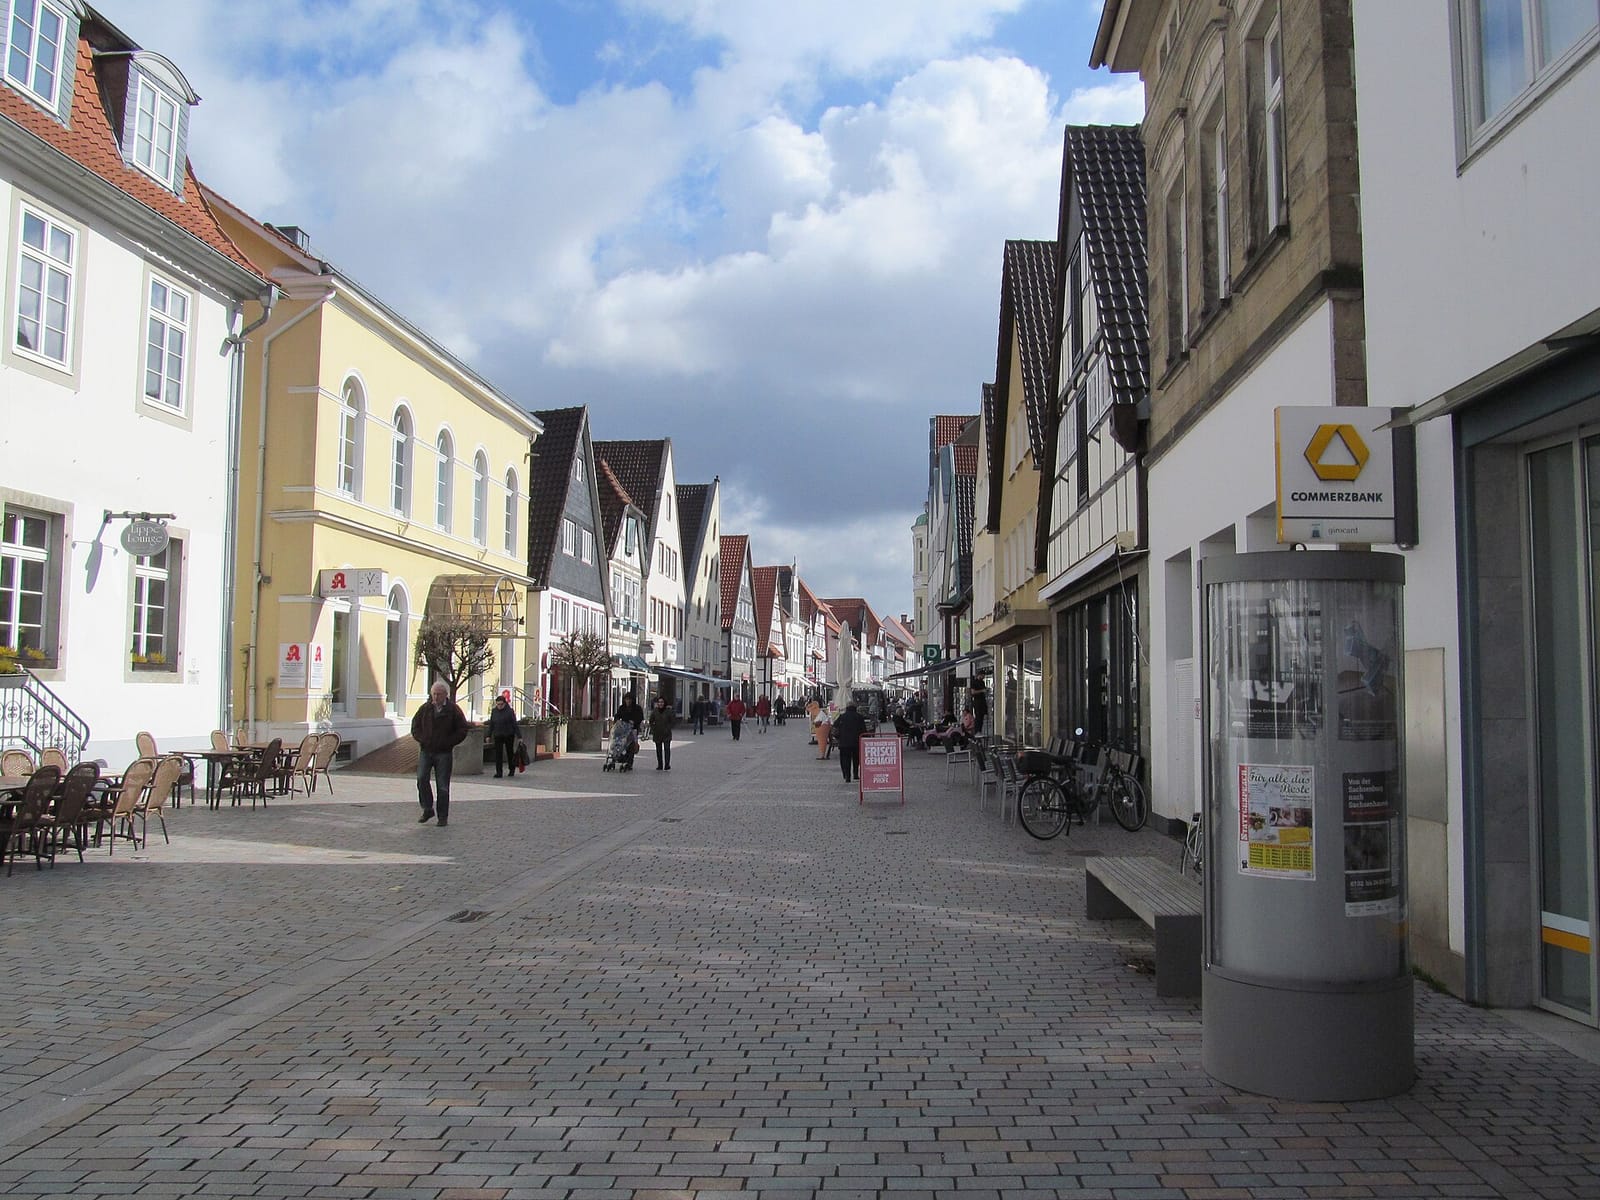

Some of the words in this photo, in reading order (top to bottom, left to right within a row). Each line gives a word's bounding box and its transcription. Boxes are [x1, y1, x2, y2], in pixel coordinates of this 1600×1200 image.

[1291, 492, 1383, 503] COMMERZBANK
[127, 533, 163, 546] Lounge
[927, 647, 937, 658] D
[865, 746, 897, 757] FRISCH
[865, 757, 897, 765] GEMACHT
[1267, 773, 1288, 784] alle
[1291, 774, 1310, 785] das
[1280, 783, 1310, 794] Beste
